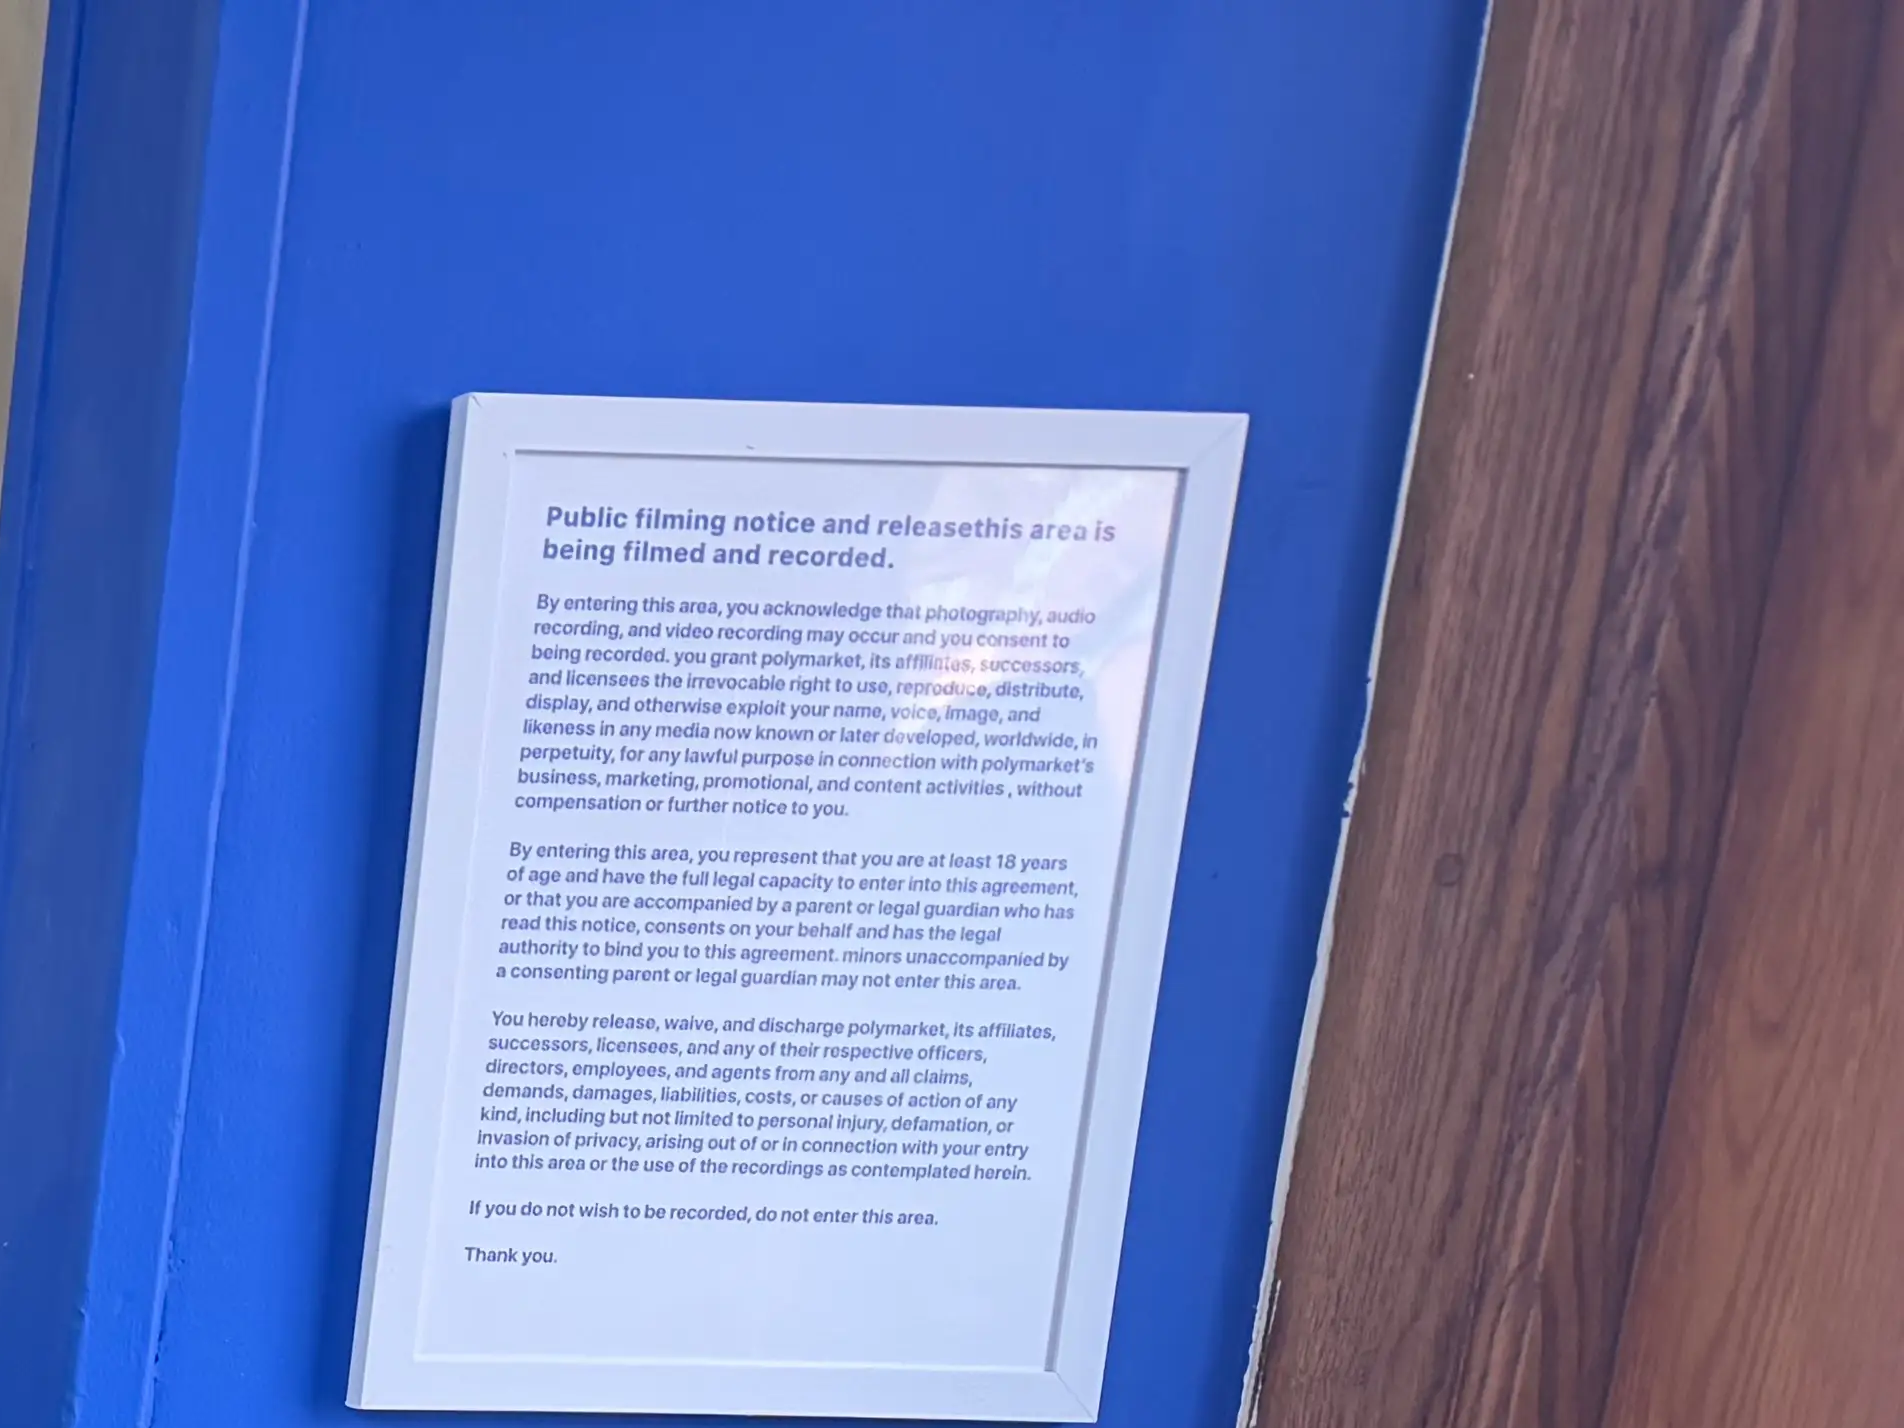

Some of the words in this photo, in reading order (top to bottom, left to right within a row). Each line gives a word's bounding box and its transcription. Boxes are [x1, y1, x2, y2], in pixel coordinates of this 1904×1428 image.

[546, 505, 629, 530] Public
[634, 507, 727, 537] filming
[732, 510, 816, 534] notice
[821, 513, 871, 536] and
[876, 514, 1023, 540] releasethis
[1029, 523, 1088, 541] area
[1094, 519, 1116, 542] is
[542, 537, 616, 567] being
[622, 539, 707, 564] filmed
[712, 543, 762, 565] and
[767, 546, 895, 569] recorded.
[533, 619, 624, 641] recording,
[627, 621, 663, 639] and
[665, 621, 715, 640] video
[716, 624, 804, 646] recording
[806, 628, 845, 648] may
[847, 630, 901, 645] occur
[902, 628, 937, 646] and
[939, 632, 973, 650] you
[975, 633, 1048, 648] consent
[1052, 633, 1071, 649] to
[519, 743, 616, 765] perpetuity,
[619, 745, 646, 763] for
[647, 749, 682, 767] any
[683, 747, 739, 765] lawful
[740, 751, 815, 769] purpose
[817, 750, 835, 768] in
[837, 752, 937, 770] connection
[940, 753, 979, 772] with
[509, 841, 533, 862] By
[535, 842, 611, 864] entering
[614, 843, 647, 861] this
[650, 848, 695, 865] area,
[696, 849, 731, 867] you
[732, 850, 819, 868] represent
[821, 849, 858, 867] that
[859, 853, 894, 870] you
[896, 854, 925, 868] are
[927, 853, 947, 868] at
[948, 852, 992, 870] least
[996, 853, 1017, 871] 18
[1019, 857, 1068, 874] years
[505, 865, 526, 883] of
[527, 869, 562, 887] age
[564, 867, 600, 884] and
[601, 867, 646, 885] have
[649, 868, 679, 886] the
[681, 869, 710, 888] full
[712, 870, 756, 892] legal
[757, 872, 835, 894] capacity
[837, 875, 856, 891] to
[858, 875, 906, 892] enter
[907, 875, 943, 893] into
[945, 876, 979, 894] this
[980, 880, 1079, 899] agreement,
[500, 915, 542, 932] read
[544, 915, 578, 932] this
[580, 916, 641, 936] notice,
[643, 920, 726, 936] consents
[728, 923, 752, 937] on
[754, 923, 795, 941] your
[797, 921, 854, 939] behalf
[855, 923, 891, 940] and
[892, 923, 925, 941] has
[928, 924, 957, 942] the
[959, 925, 1003, 946] legal
[498, 938, 579, 960] authority
[582, 941, 601, 957] to
[603, 940, 644, 958] bind
[646, 945, 680, 962] you
[682, 944, 701, 960] to
[703, 943, 737, 961] this
[739, 947, 840, 965] agreement.
[841, 946, 903, 965] minors
[905, 951, 1046, 970] unaccompanied
[1047, 952, 1070, 972] by
[491, 1010, 525, 1027] You
[527, 1011, 590, 1033] hereby
[591, 1013, 661, 1033] release,
[664, 1014, 719, 1035] waive,
[721, 1017, 756, 1033] and
[758, 1016, 845, 1039] discharge
[846, 1019, 950, 1041] polymarket,
[952, 1021, 975, 1039] its
[977, 1022, 1056, 1042] affiliates,
[488, 1037, 594, 1056] successors,
[595, 1036, 683, 1059] licensees,
[686, 1039, 721, 1056] and
[722, 1043, 756, 1061] any
[757, 1041, 777, 1057] of
[779, 1041, 822, 1059] their
[822, 1043, 914, 1063] respective
[916, 1044, 988, 1065] officers,
[484, 1058, 569, 1079] directors,
[571, 1060, 672, 1081] employees,
[673, 1063, 709, 1080] and
[710, 1065, 772, 1084] agents
[774, 1064, 816, 1083] from
[818, 1069, 851, 1087] any
[853, 1067, 888, 1084] and
[889, 1067, 911, 1084] all
[912, 1068, 973, 1088] claims,
[482, 1081, 569, 1103] demands,
[571, 1083, 658, 1105] damages,
[660, 1085, 742, 1107] liabilities,
[744, 1089, 797, 1108] costs,
[799, 1092, 819, 1106] or
[820, 1092, 884, 1108] causes
[886, 1091, 905, 1108] of
[907, 1091, 962, 1109] action
[964, 1093, 984, 1109] of
[985, 1096, 1019, 1114] any
[468, 1199, 482, 1216] If
[483, 1203, 517, 1220] you
[519, 1200, 544, 1217] do
[545, 1203, 576, 1218] not
[578, 1202, 620, 1219] wish
[622, 1204, 642, 1220] to
[643, 1203, 667, 1220] be
[669, 1205, 752, 1225] recorded,
[754, 1205, 778, 1223] do
[780, 1208, 810, 1223] not
[812, 1208, 860, 1224] enter
[861, 1208, 894, 1225] this
[896, 1212, 939, 1226] area.
[464, 1246, 519, 1263] Thank
[520, 1250, 558, 1267] you.
